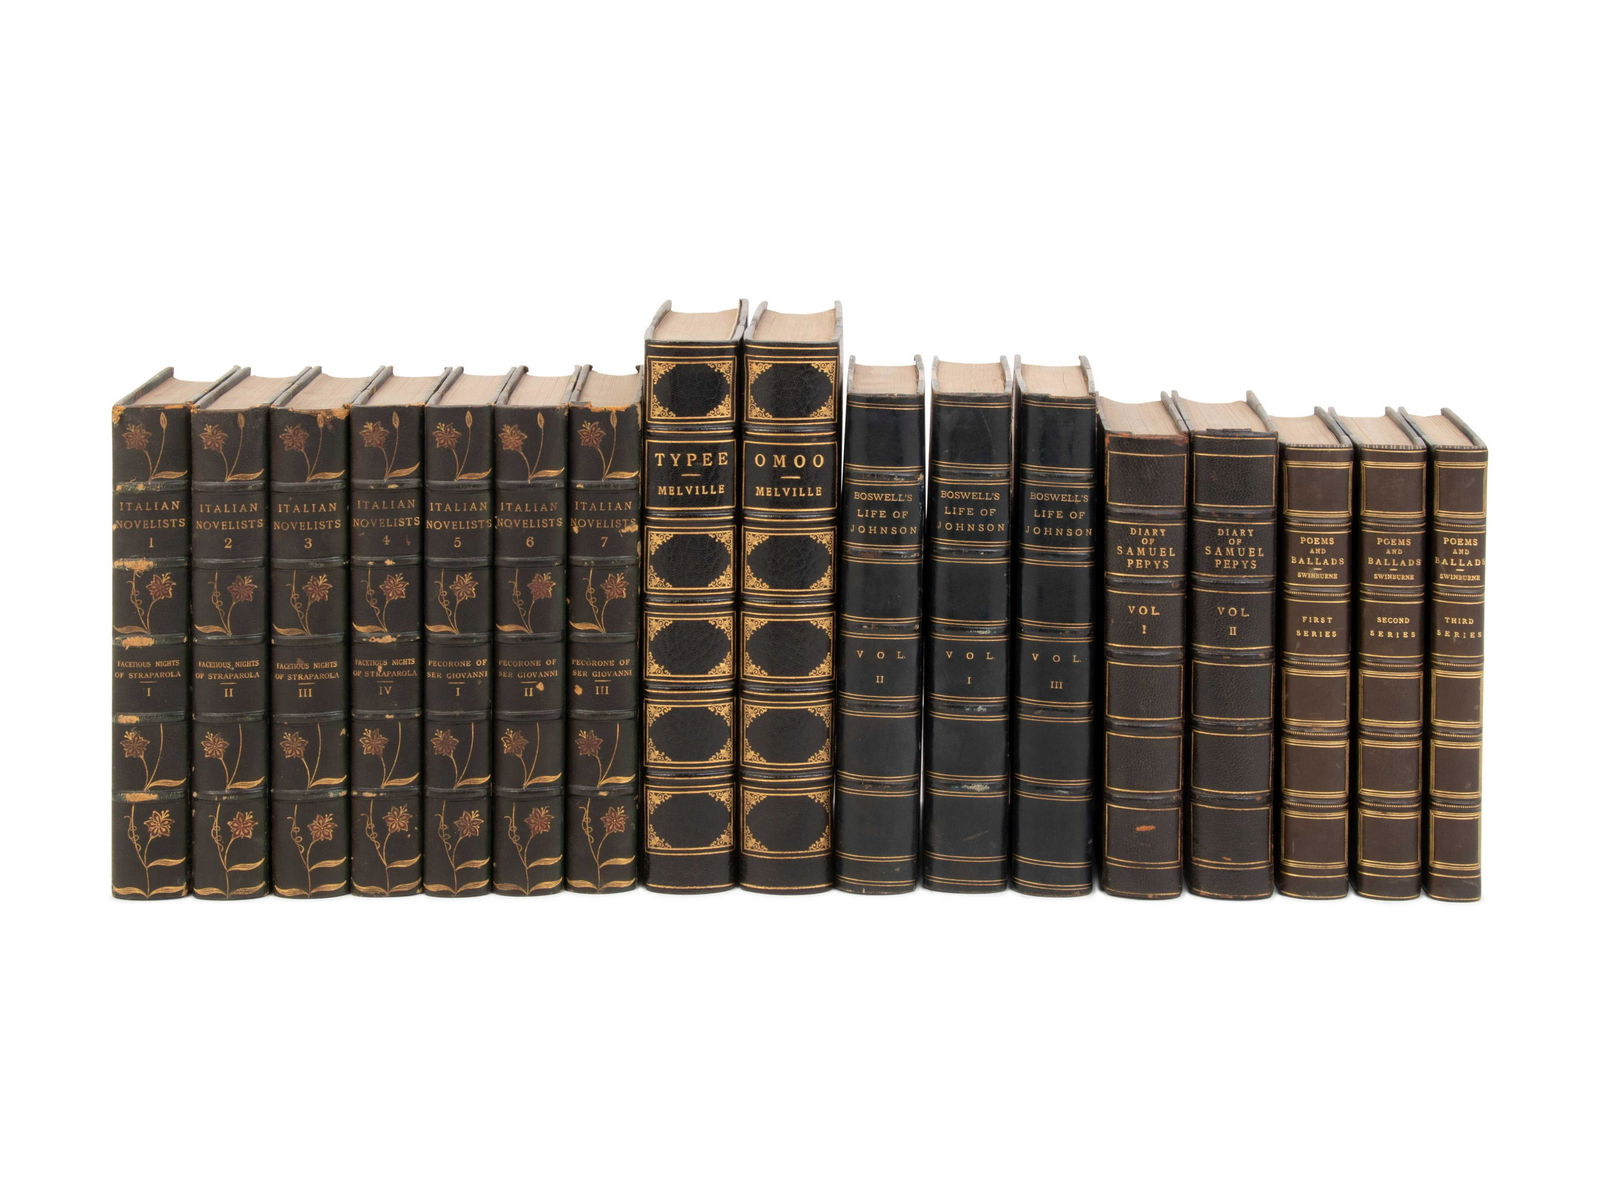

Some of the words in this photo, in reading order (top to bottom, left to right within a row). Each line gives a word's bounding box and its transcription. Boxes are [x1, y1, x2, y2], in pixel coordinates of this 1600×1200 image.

[654, 452, 729, 467] TYPEE
[754, 454, 825, 469] OMOO
[658, 485, 725, 496] MELVILLE
[755, 486, 823, 497] MELVILLE
[940, 490, 1001, 501] BOSWELL'S
[854, 491, 913, 502] BOSWELL'S
[1029, 492, 1089, 503] BOSWELL'S
[119, 501, 181, 511] ITALIAN
[199, 503, 258, 513] ITALIAN
[278, 503, 338, 513] ITALIAN
[357, 499, 416, 511] ITALIAN
[429, 501, 488, 512] ITALIAN
[500, 502, 558, 512] ITALIAN
[575, 501, 633, 511] ITALIAN
[856, 509, 887, 519] LIFE
[892, 510, 909, 519] OF
[944, 507, 974, 516] LIFE
[980, 508, 997, 517] OF
[1033, 509, 1064, 519] LIFE
[1069, 511, 1086, 520] OF
[115, 518, 186, 530] NOVELISTS
[196, 519, 264, 530] NOVELISTS
[273, 519, 342, 531] NOVELISTS
[352, 517, 421, 528] NOVELISTS
[426, 519, 493, 530] NOVELISTS
[496, 517, 563, 529] NOVELISTS
[570, 518, 637, 529] NOVELISTS
[937, 521, 1005, 532] JOHNSON
[850, 525, 918, 535] JOHNSON
[1025, 525, 1093, 537] JOHNSON
[1130, 528, 1166, 536] DIARY
[1217, 528, 1254, 537] DIARY
[224, 538, 233, 549] 2
[304, 538, 313, 549] 3
[382, 535, 391, 546] 4
[453, 537, 462, 548] 5
[526, 536, 535, 548] 6
[600, 536, 609, 548] 7
[1228, 538, 1243, 546] OF
[1300, 537, 1335, 545] POEMS
[1377, 537, 1412, 546] POEMS
[1443, 537, 1479, 546] POEMS
[1116, 546, 1176, 557] SAMUEL
[1204, 546, 1265, 557] SAMUEL
[1127, 559, 1169, 569] PEPYS
[1215, 560, 1257, 569] PEPYS
[1291, 556, 1345, 566] BALLADS
[1367, 557, 1422, 567] BALLADS
[1297, 572, 1338, 580] SWINBURNE
[1373, 573, 1415, 581] SWINBURNE
[1439, 573, 1481, 581] SWINBURNE
[1302, 616, 1333, 624] FIRST
[1377, 617, 1410, 625] SECOND
[1444, 617, 1474, 625] THIRD
[1229, 626, 1237, 636] II
[1296, 630, 1337, 638] SERIES
[1370, 630, 1416, 639] SERIES
[1436, 630, 1482, 639] SERIES
[155, 660, 181, 668] NIGHTS
[234, 660, 260, 668] NIGHTS
[313, 661, 338, 669] NIGHTS
[392, 658, 416, 666] NIGHTS
[428, 659, 472, 667] PECORONE
[476, 659, 488, 667] OF
[498, 659, 542, 667] PECORONE
[546, 658, 558, 666] OF
[571, 659, 615, 667] PECORONE
[619, 658, 631, 666] OF
[114, 671, 125, 679] OF
[128, 671, 182, 679] STRAPAROLA
[195, 672, 205, 680] OF
[207, 671, 261, 680] STRAPAROLA
[275, 672, 285, 680] OF
[287, 672, 340, 681] STRAPAROLA
[427, 671, 444, 679] SER
[446, 671, 489, 680] GIOVANNI
[517, 670, 558, 679] GIOVANNI
[591, 669, 632, 678] GIOVANNI
[876, 675, 884, 684] II
[1050, 681, 1064, 689] III
[147, 687, 151, 697] I
[224, 688, 234, 698] II
[298, 688, 313, 698] III
[379, 686, 393, 696] IV
[455, 687, 460, 697] I
[523, 687, 534, 697] II
[595, 685, 610, 696] III
